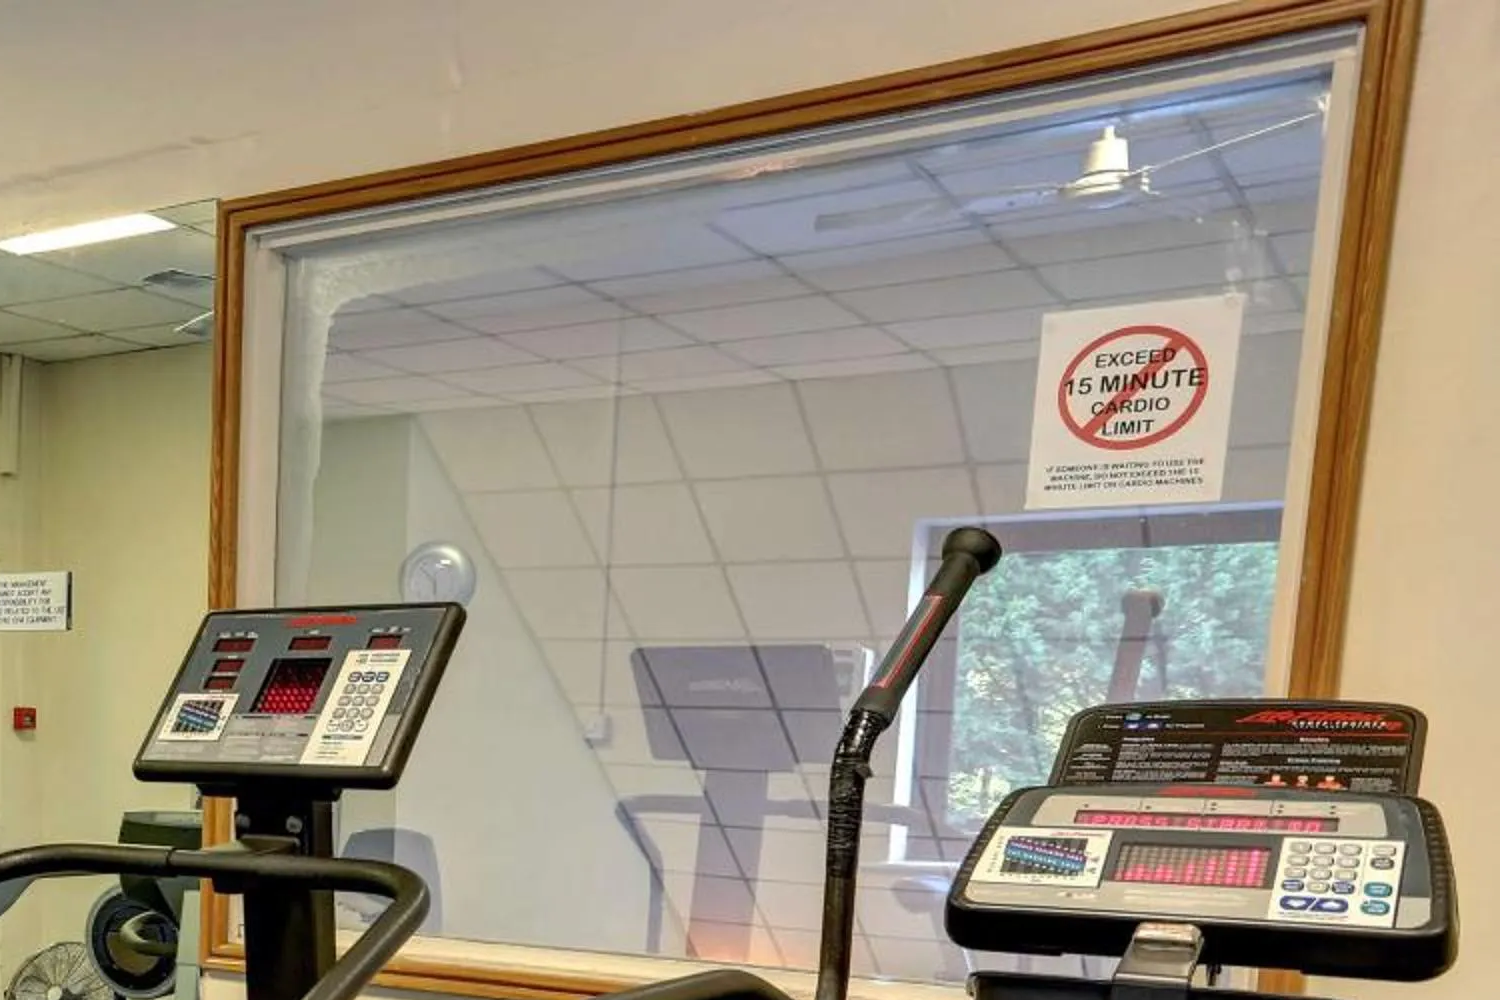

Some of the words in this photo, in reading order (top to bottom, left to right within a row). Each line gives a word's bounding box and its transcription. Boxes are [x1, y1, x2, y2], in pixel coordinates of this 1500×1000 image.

[1094, 347, 1177, 368] EXCEED
[1064, 378, 1092, 396] 15
[1100, 367, 1206, 394] MINUTE
[1091, 397, 1171, 416] CARDIO
[1101, 419, 1155, 437] LIMIT
